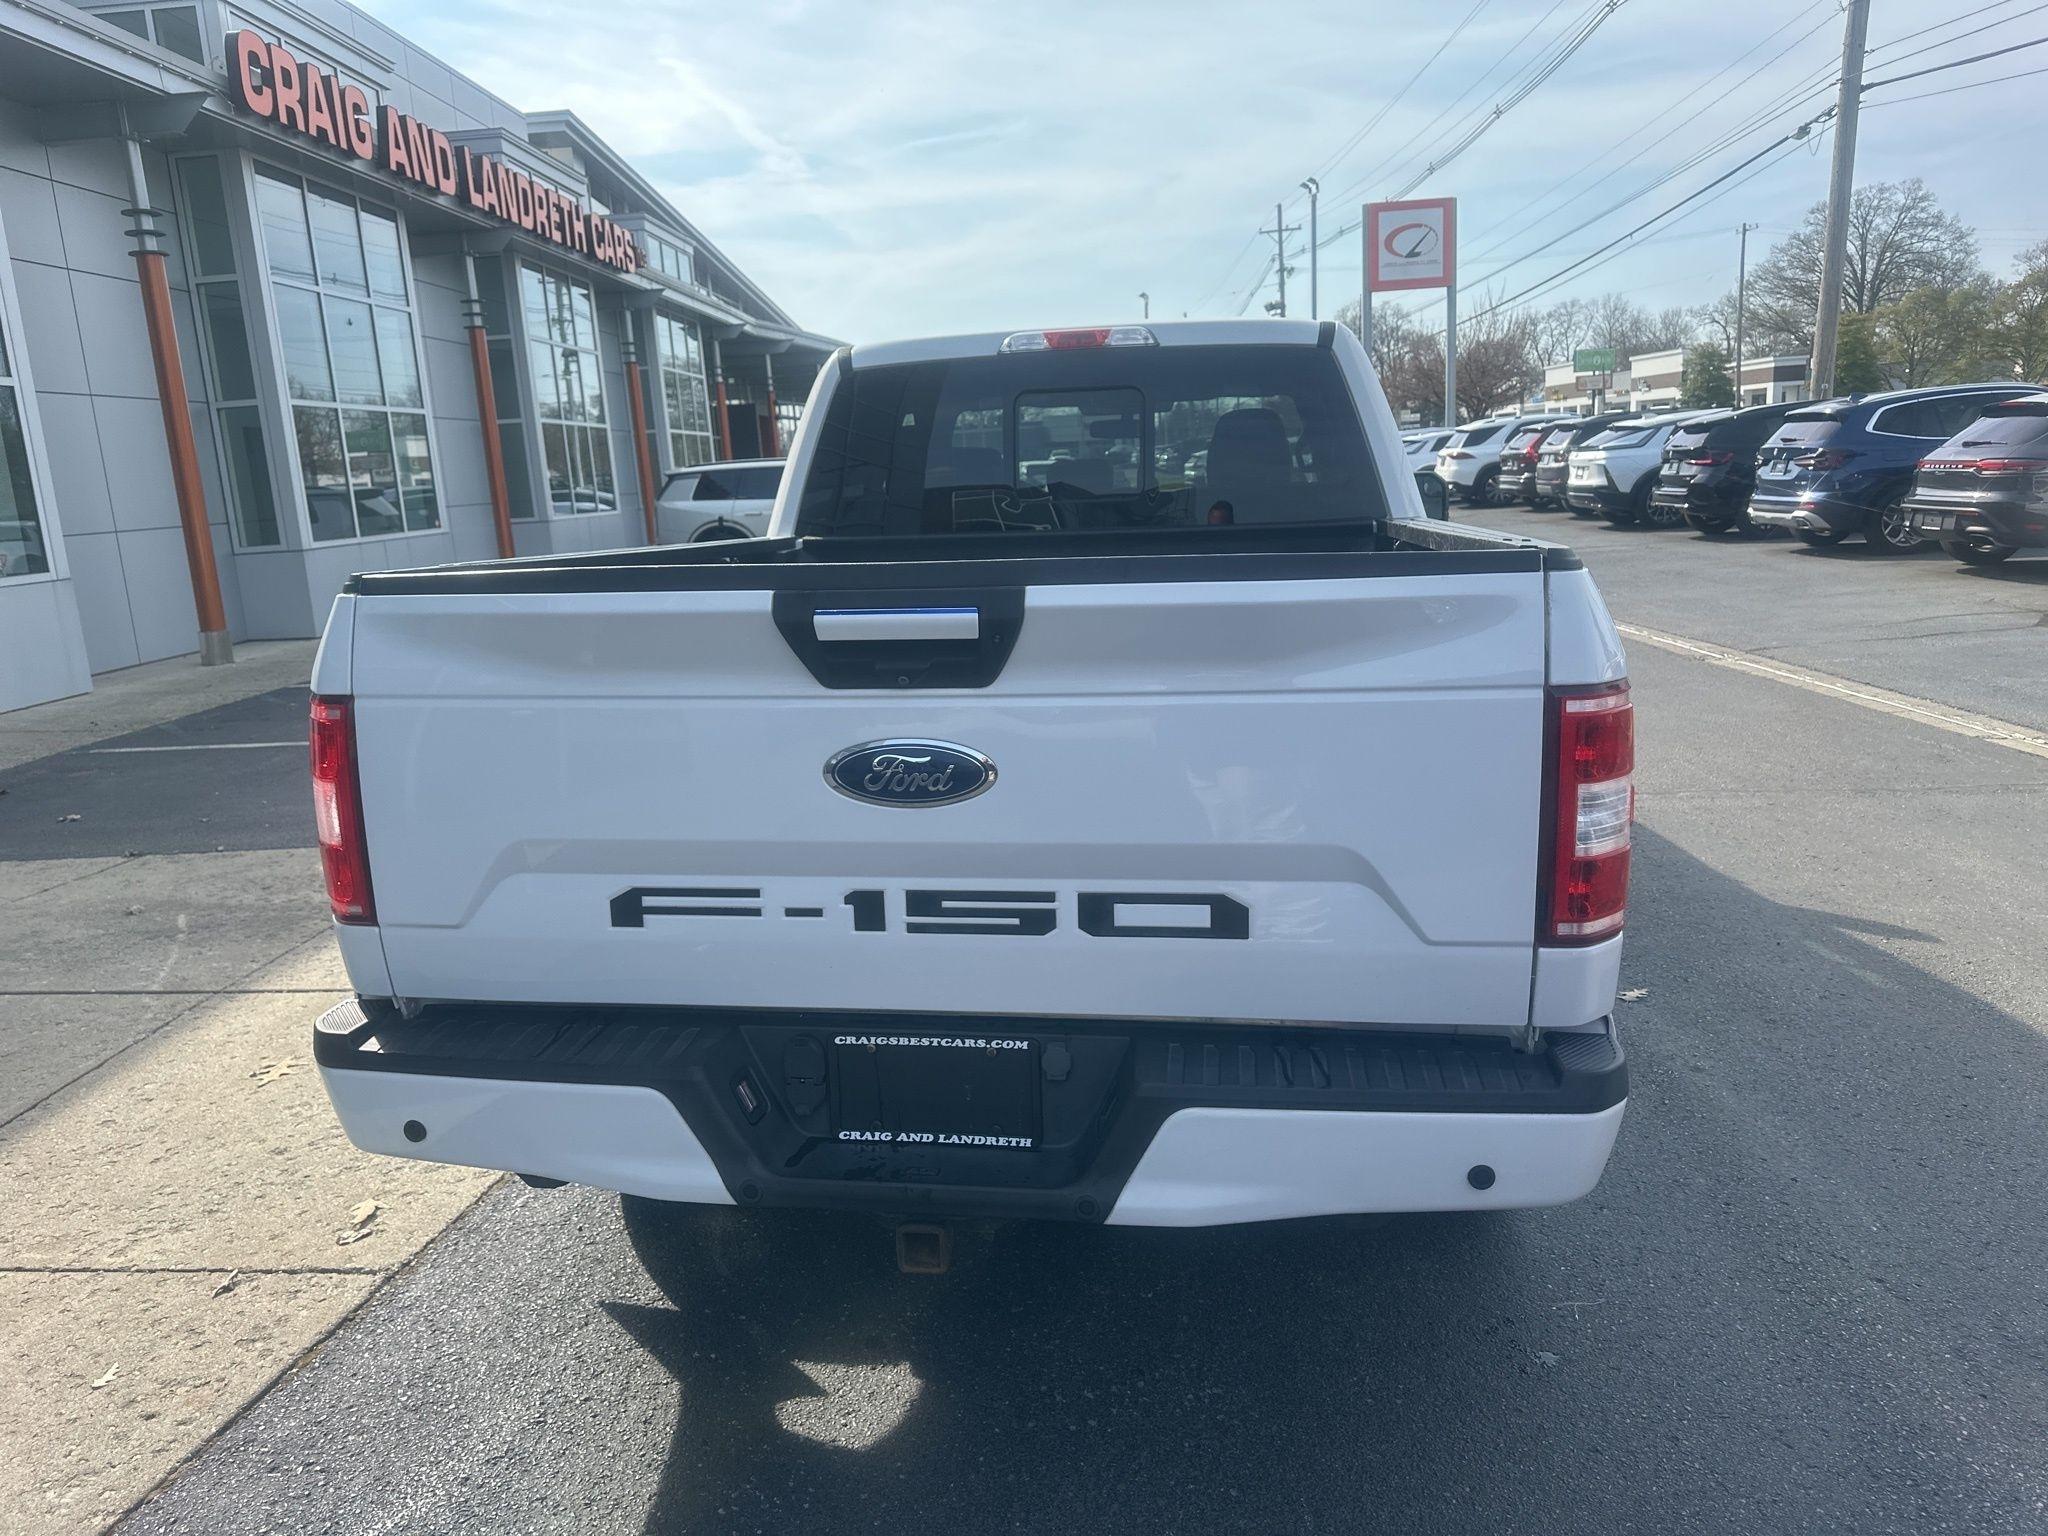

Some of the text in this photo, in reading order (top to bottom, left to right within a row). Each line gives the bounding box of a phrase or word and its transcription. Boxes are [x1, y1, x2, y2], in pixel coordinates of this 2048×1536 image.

[233, 29, 637, 273] CRAIG AND LANDRETH CARS
[863, 754, 955, 792] Ford
[610, 886, 1250, 940] F-150
[834, 1035, 1029, 1050] CRAIGSBESTCARS.COM
[838, 1131, 1032, 1147] CRAIG AND LANDRETH
